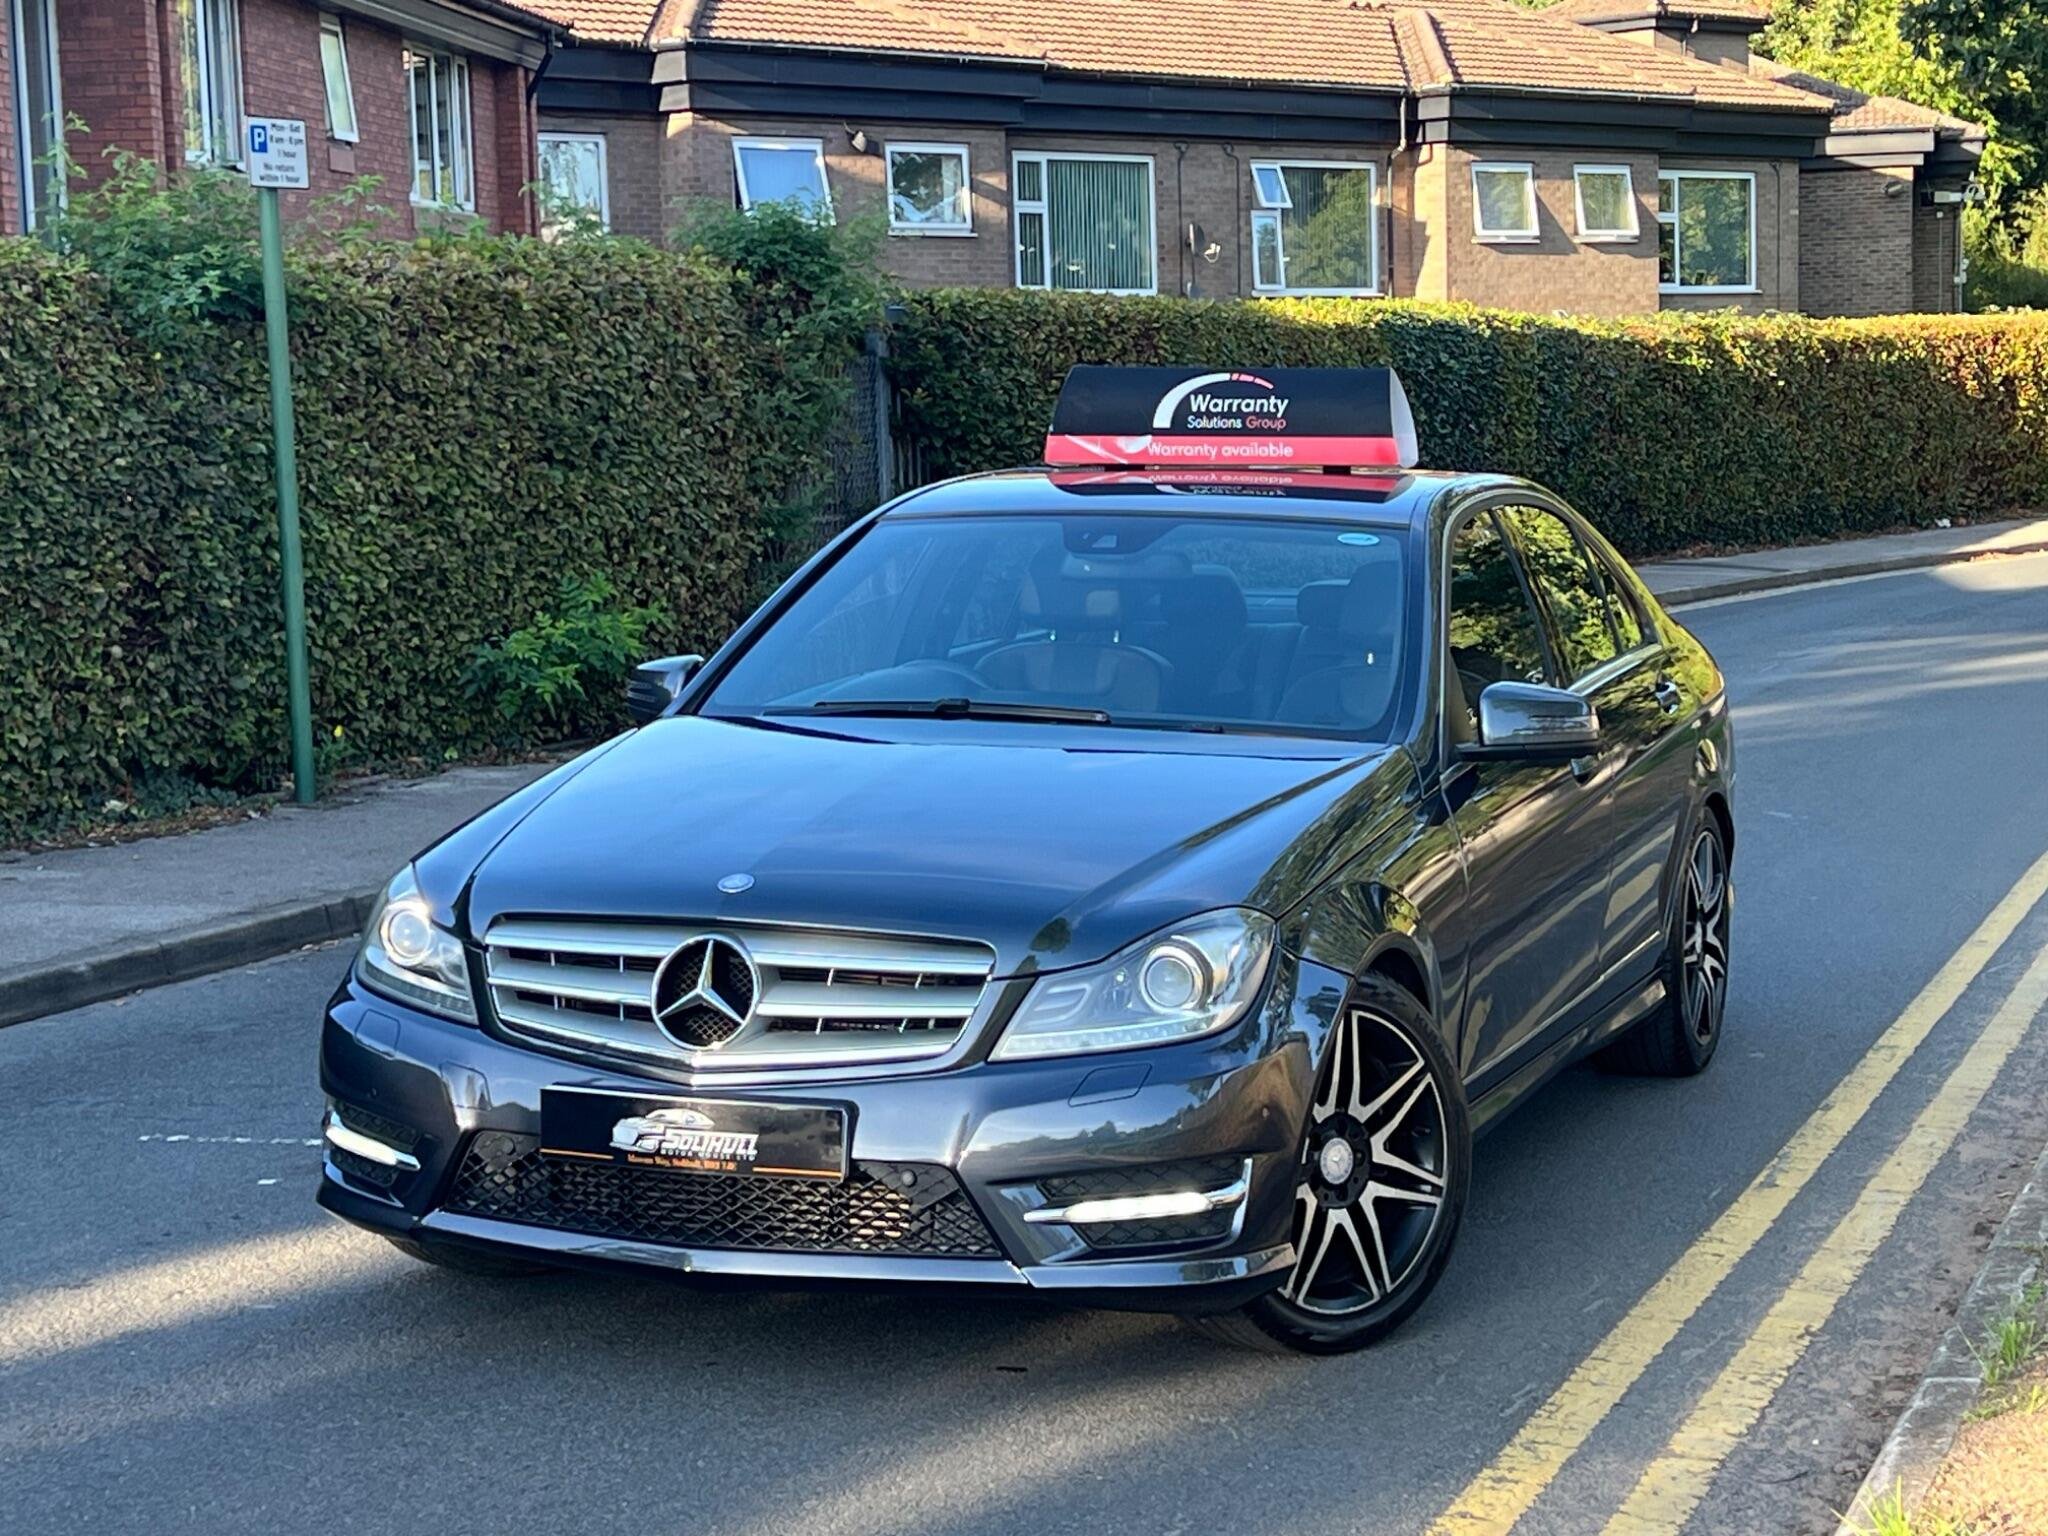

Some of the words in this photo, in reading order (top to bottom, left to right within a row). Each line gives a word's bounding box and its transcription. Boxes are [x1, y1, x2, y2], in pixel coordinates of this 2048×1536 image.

[253, 127, 266, 151] P
[1190, 394, 1289, 418] Warranty
[1187, 415, 1242, 429] Solutions
[1246, 416, 1287, 431] Group
[1147, 441, 1217, 461] Warranty
[1221, 441, 1294, 458] available
[660, 1129, 759, 1155] SOLIHULL
